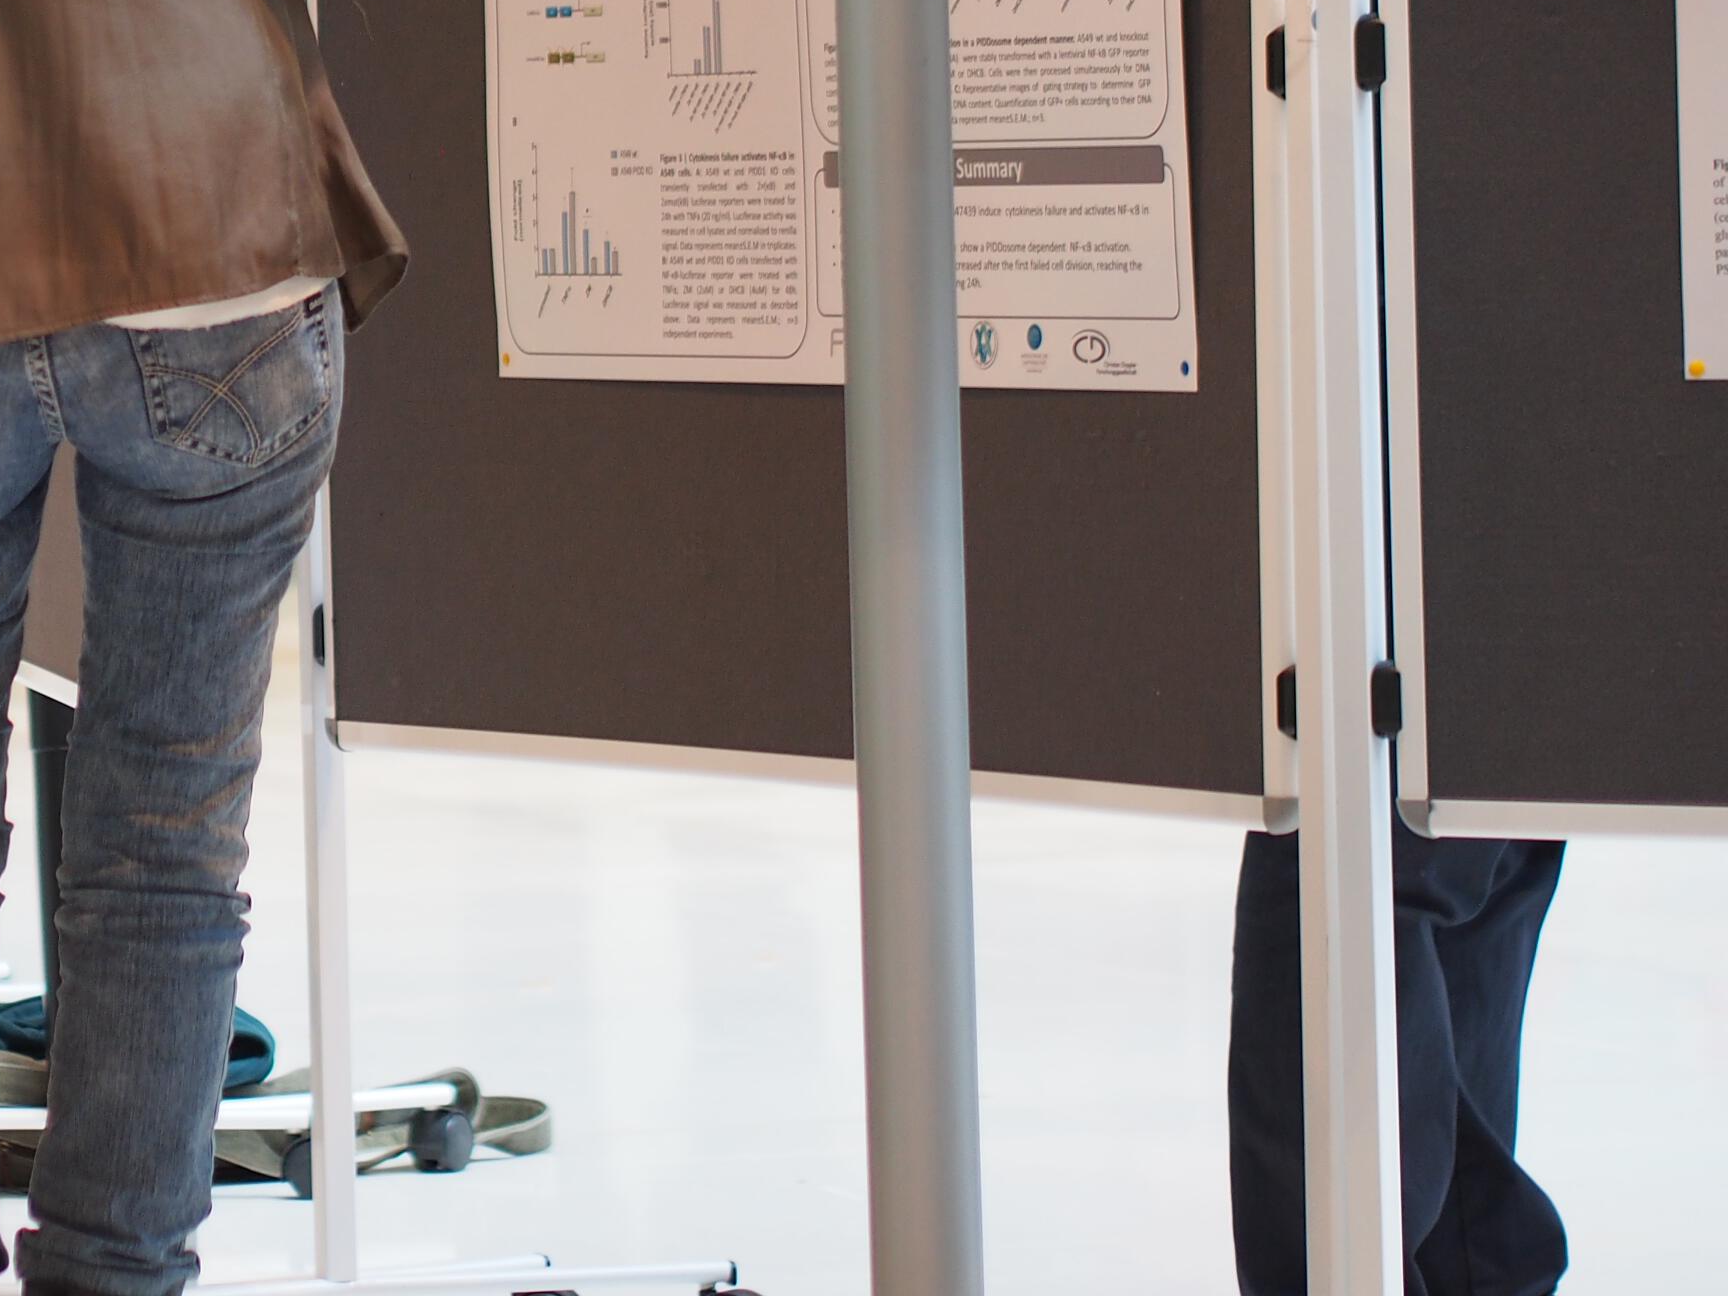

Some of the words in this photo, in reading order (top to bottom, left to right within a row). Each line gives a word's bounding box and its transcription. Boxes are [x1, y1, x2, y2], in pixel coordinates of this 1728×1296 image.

[976, 36, 1012, 47] PIDDosome
[1014, 36, 1048, 48] dependent
[1106, 32, 1118, 42] and
[1120, 32, 1149, 42] knockout
[998, 50, 1037, 62] transformed
[1038, 50, 1052, 60] with
[1122, 48, 1150, 59] reporter
[988, 67, 1002, 77] Cells
[1006, 68, 1021, 76] were
[1024, 66, 1038, 76] then
[1040, 65, 1071, 78] processed
[1074, 64, 1120, 77] simultaneously
[1123, 64, 1132, 73] for
[1135, 64, 1151, 73] DNA
[963, 82, 1007, 94] Representative
[1009, 82, 1030, 94] images
[1032, 81, 1040, 91] of
[1042, 82, 1062, 94] gating
[1064, 80, 1088, 93] strategy
[1101, 79, 1134, 90] determine
[1138, 78, 1152, 88] GFP
[994, 98, 1038, 109] Quantification
[1039, 96, 1046, 107] of
[1064, 96, 1079, 106] cells
[1081, 96, 1110, 108] according
[1120, 95, 1135, 104] their
[1137, 94, 1152, 104] DNA
[660, 153, 677, 164] Figure
[689, 152, 720, 164] Cytokinesis
[722, 152, 739, 162] failure
[741, 152, 767, 162] activates
[956, 158, 1023, 184] Summary
[978, 206, 1002, 216] induce
[1005, 204, 1044, 218] cytokinesis
[1044, 204, 1067, 216] failure
[1069, 205, 1083, 216] and
[1084, 204, 1116, 216] activates
[1142, 205, 1150, 216] in
[960, 242, 980, 253] show
[980, 244, 985, 252] a
[986, 241, 1026, 253] PIDDosome
[1028, 241, 1066, 255] dependent
[1094, 241, 1132, 253] activation.
[983, 260, 1000, 272] after
[1002, 260, 1014, 271] the
[1014, 260, 1030, 271] first
[1030, 260, 1050, 271] failed
[1052, 260, 1064, 271] cell
[1066, 260, 1096, 272] division,
[1096, 260, 1128, 274] reaching
[1130, 260, 1143, 272] the
